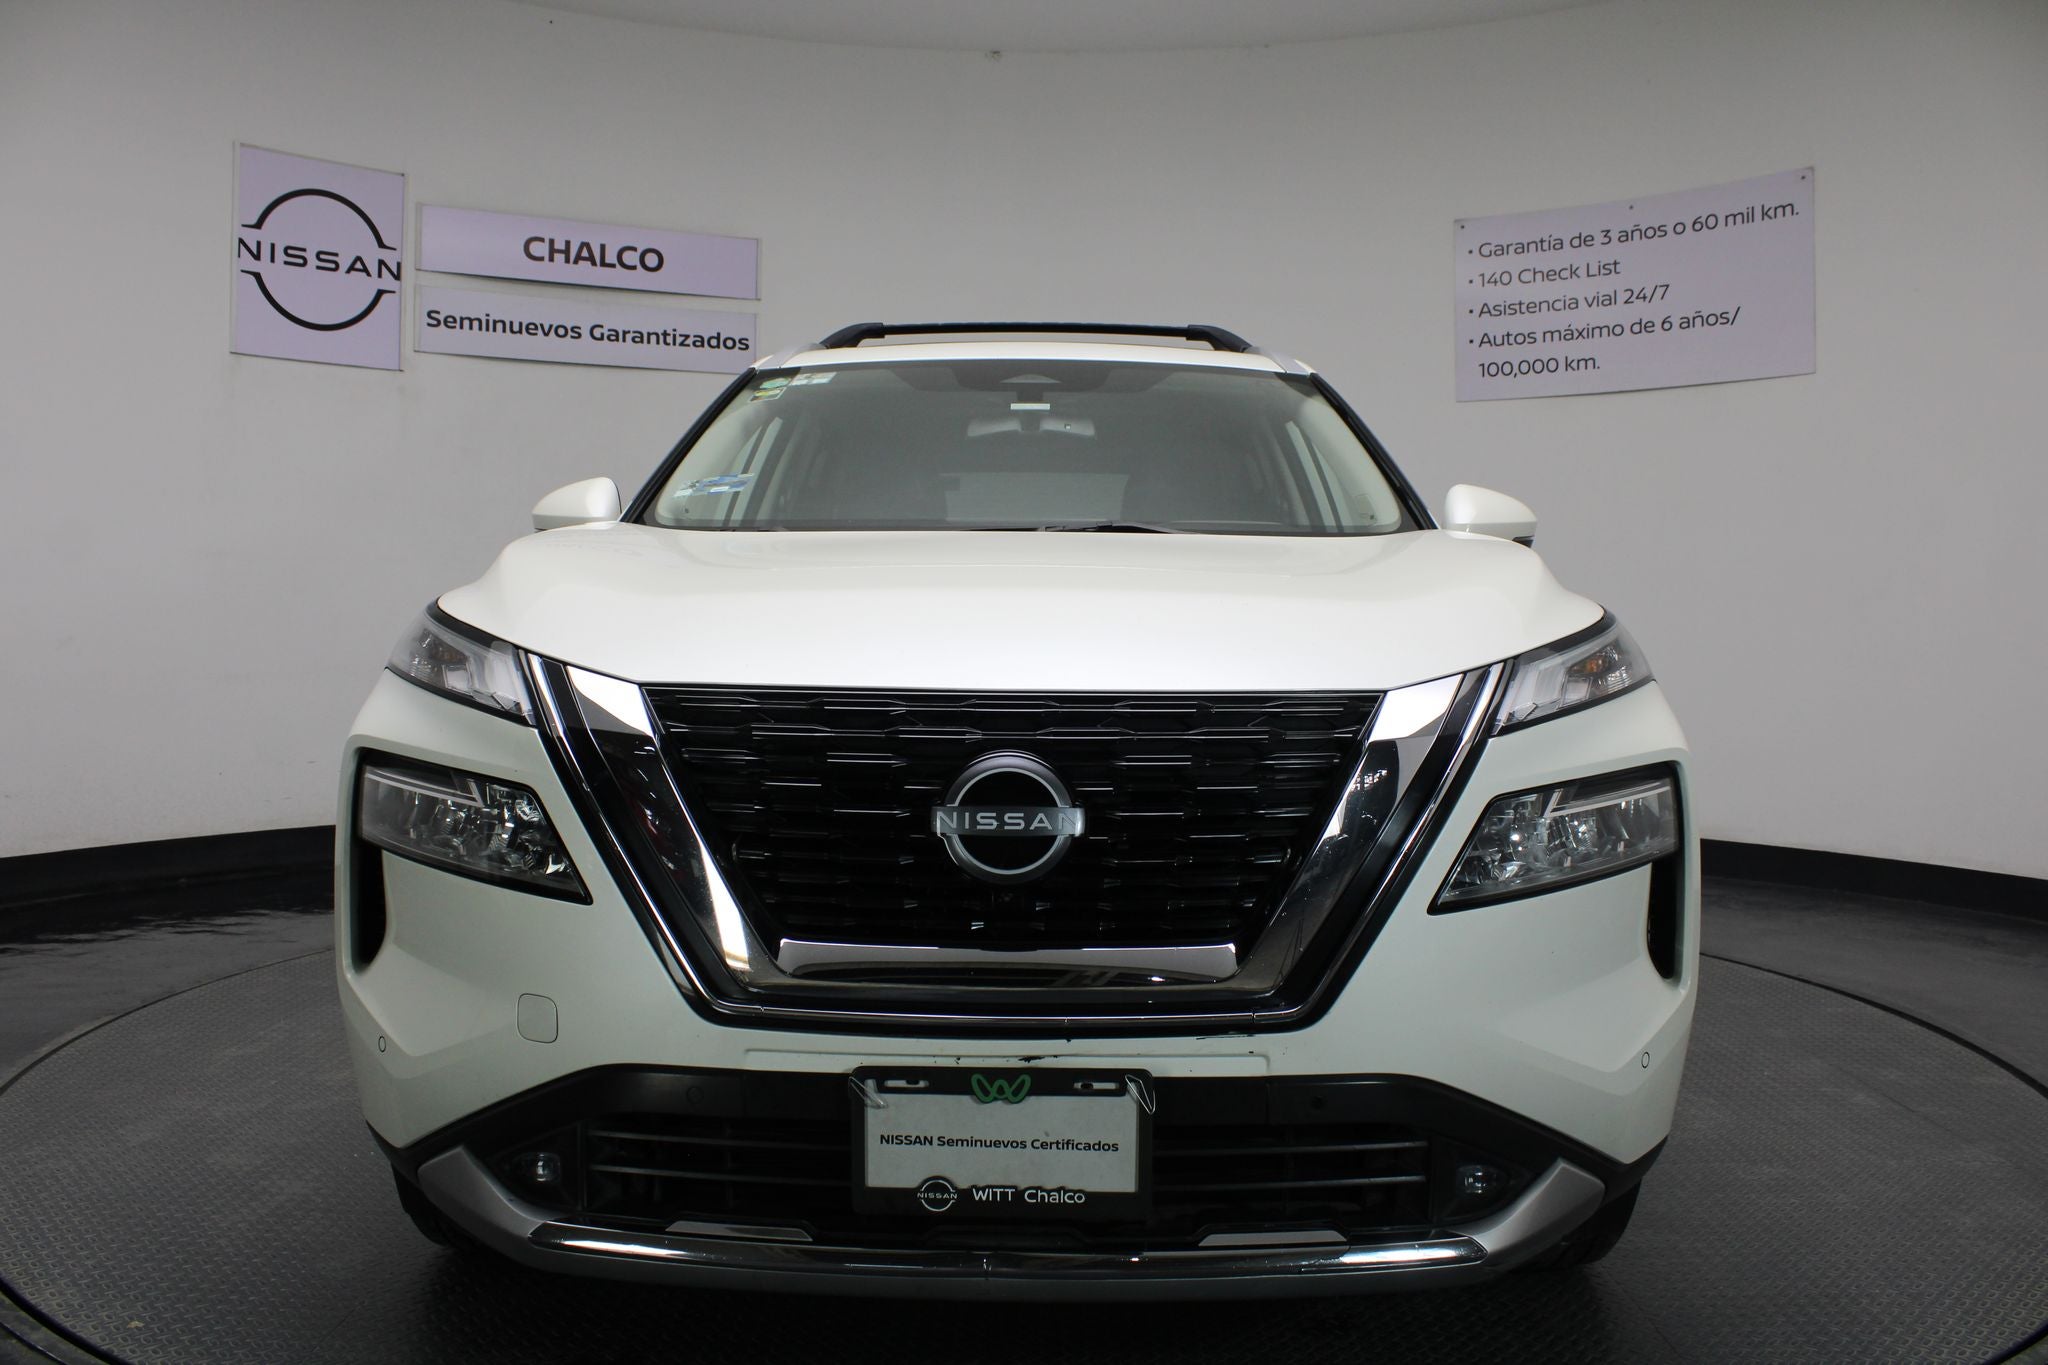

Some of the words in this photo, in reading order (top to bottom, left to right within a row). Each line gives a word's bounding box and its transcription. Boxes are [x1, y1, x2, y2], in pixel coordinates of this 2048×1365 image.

[1478, 233, 1564, 259] Garantía
[1569, 231, 1595, 250] de
[1600, 229, 1612, 246] 3
[1617, 223, 1668, 243] años
[1672, 221, 1686, 236] o
[1691, 213, 1719, 233] 60
[1724, 206, 1755, 228] mil
[1761, 201, 1800, 222] km.
[237, 236, 402, 282] NISSAN
[522, 235, 665, 273] CHALCO
[1478, 269, 1513, 288] 140
[1517, 263, 1580, 285] Check
[1586, 258, 1621, 279] List
[1478, 294, 1579, 319] Asistencia
[1584, 289, 1617, 308] vial
[1623, 284, 1670, 304] 24/7
[425, 308, 582, 341] Seminuevos
[589, 322, 750, 352] Garantizados
[1478, 330, 1537, 349] Autos
[1542, 322, 1624, 344] máximo
[1629, 317, 1656, 336] de
[1661, 314, 1673, 333] 6
[1679, 306, 1741, 330] años/
[1478, 356, 1559, 379] 100,000
[1564, 354, 1600, 373] km.
[936, 810, 1081, 831] NISSAN
[879, 1133, 934, 1146] NISSAN
[936, 1135, 1027, 1150] Seminuevos
[1030, 1137, 1119, 1152] Certificados
[917, 1191, 958, 1200] NISSAN
[972, 1187, 1016, 1202] WITT
[1023, 1188, 1086, 1204] Chalco
